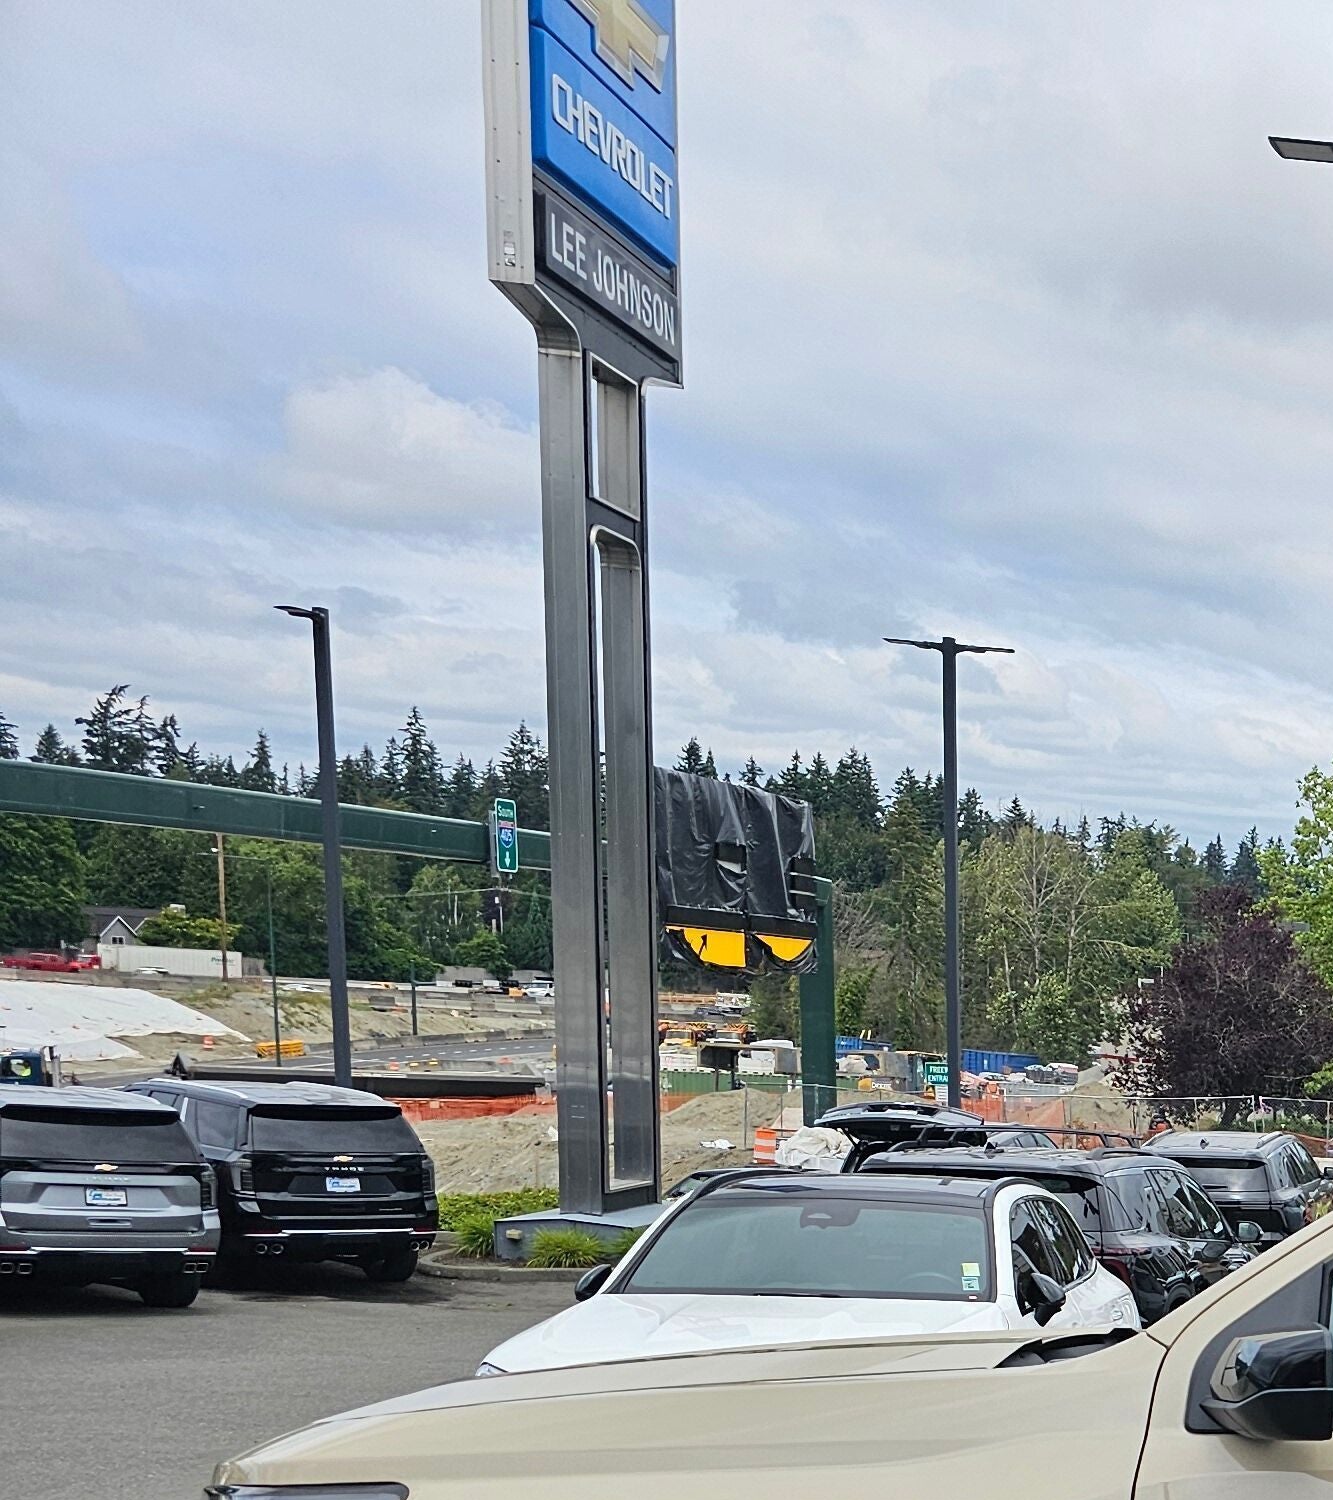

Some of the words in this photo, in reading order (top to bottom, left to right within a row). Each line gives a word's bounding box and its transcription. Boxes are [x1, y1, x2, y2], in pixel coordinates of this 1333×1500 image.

[552, 73, 674, 221] CHEVROLET
[551, 212, 588, 281] LEE
[591, 248, 676, 346] JOHNSON
